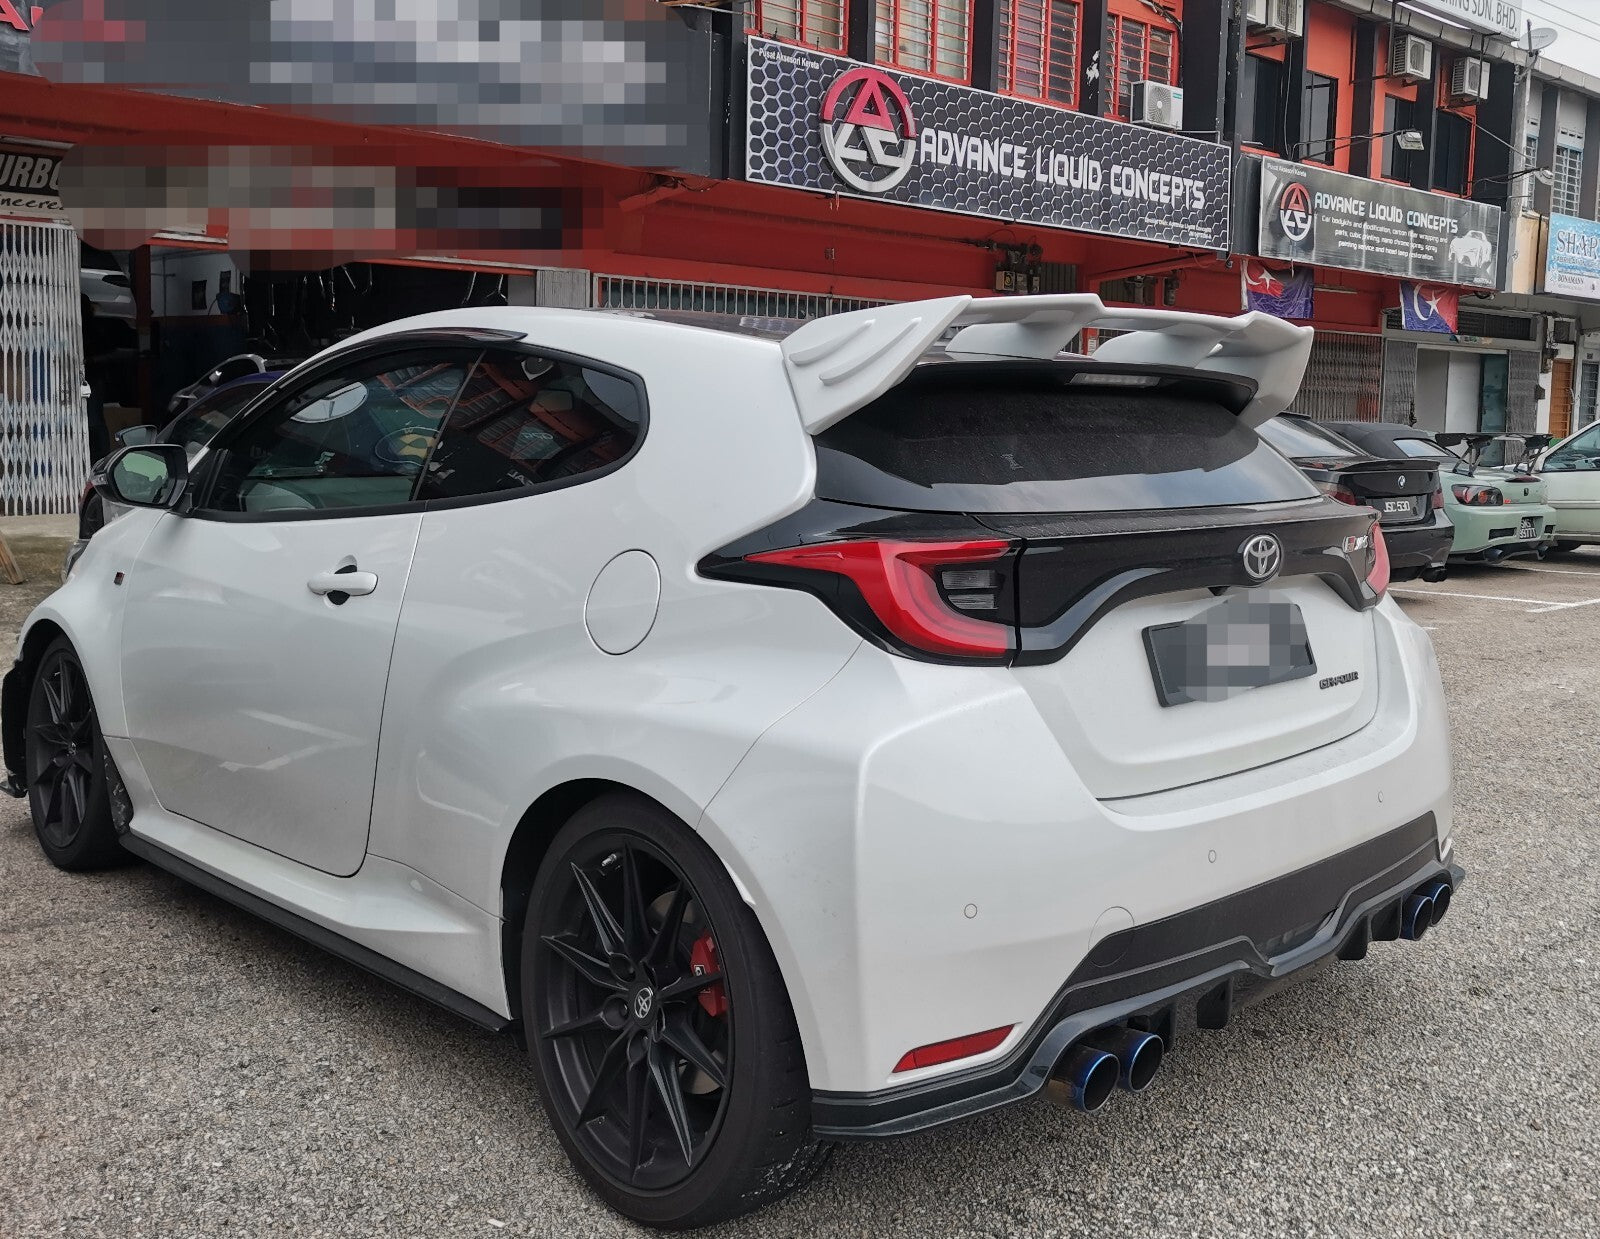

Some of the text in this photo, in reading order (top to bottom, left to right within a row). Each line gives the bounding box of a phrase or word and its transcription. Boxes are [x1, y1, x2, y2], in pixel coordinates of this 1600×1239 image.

[1496, 2, 1517, 31] BHD.
[759, 48, 775, 60] Pusat
[920, 127, 1206, 210] ADVANCE LIQUID CONCEPTS
[1314, 192, 1458, 234] ADVANCE LIQUID CONCEPTS
[1383, 500, 1410, 512] JSC 530
